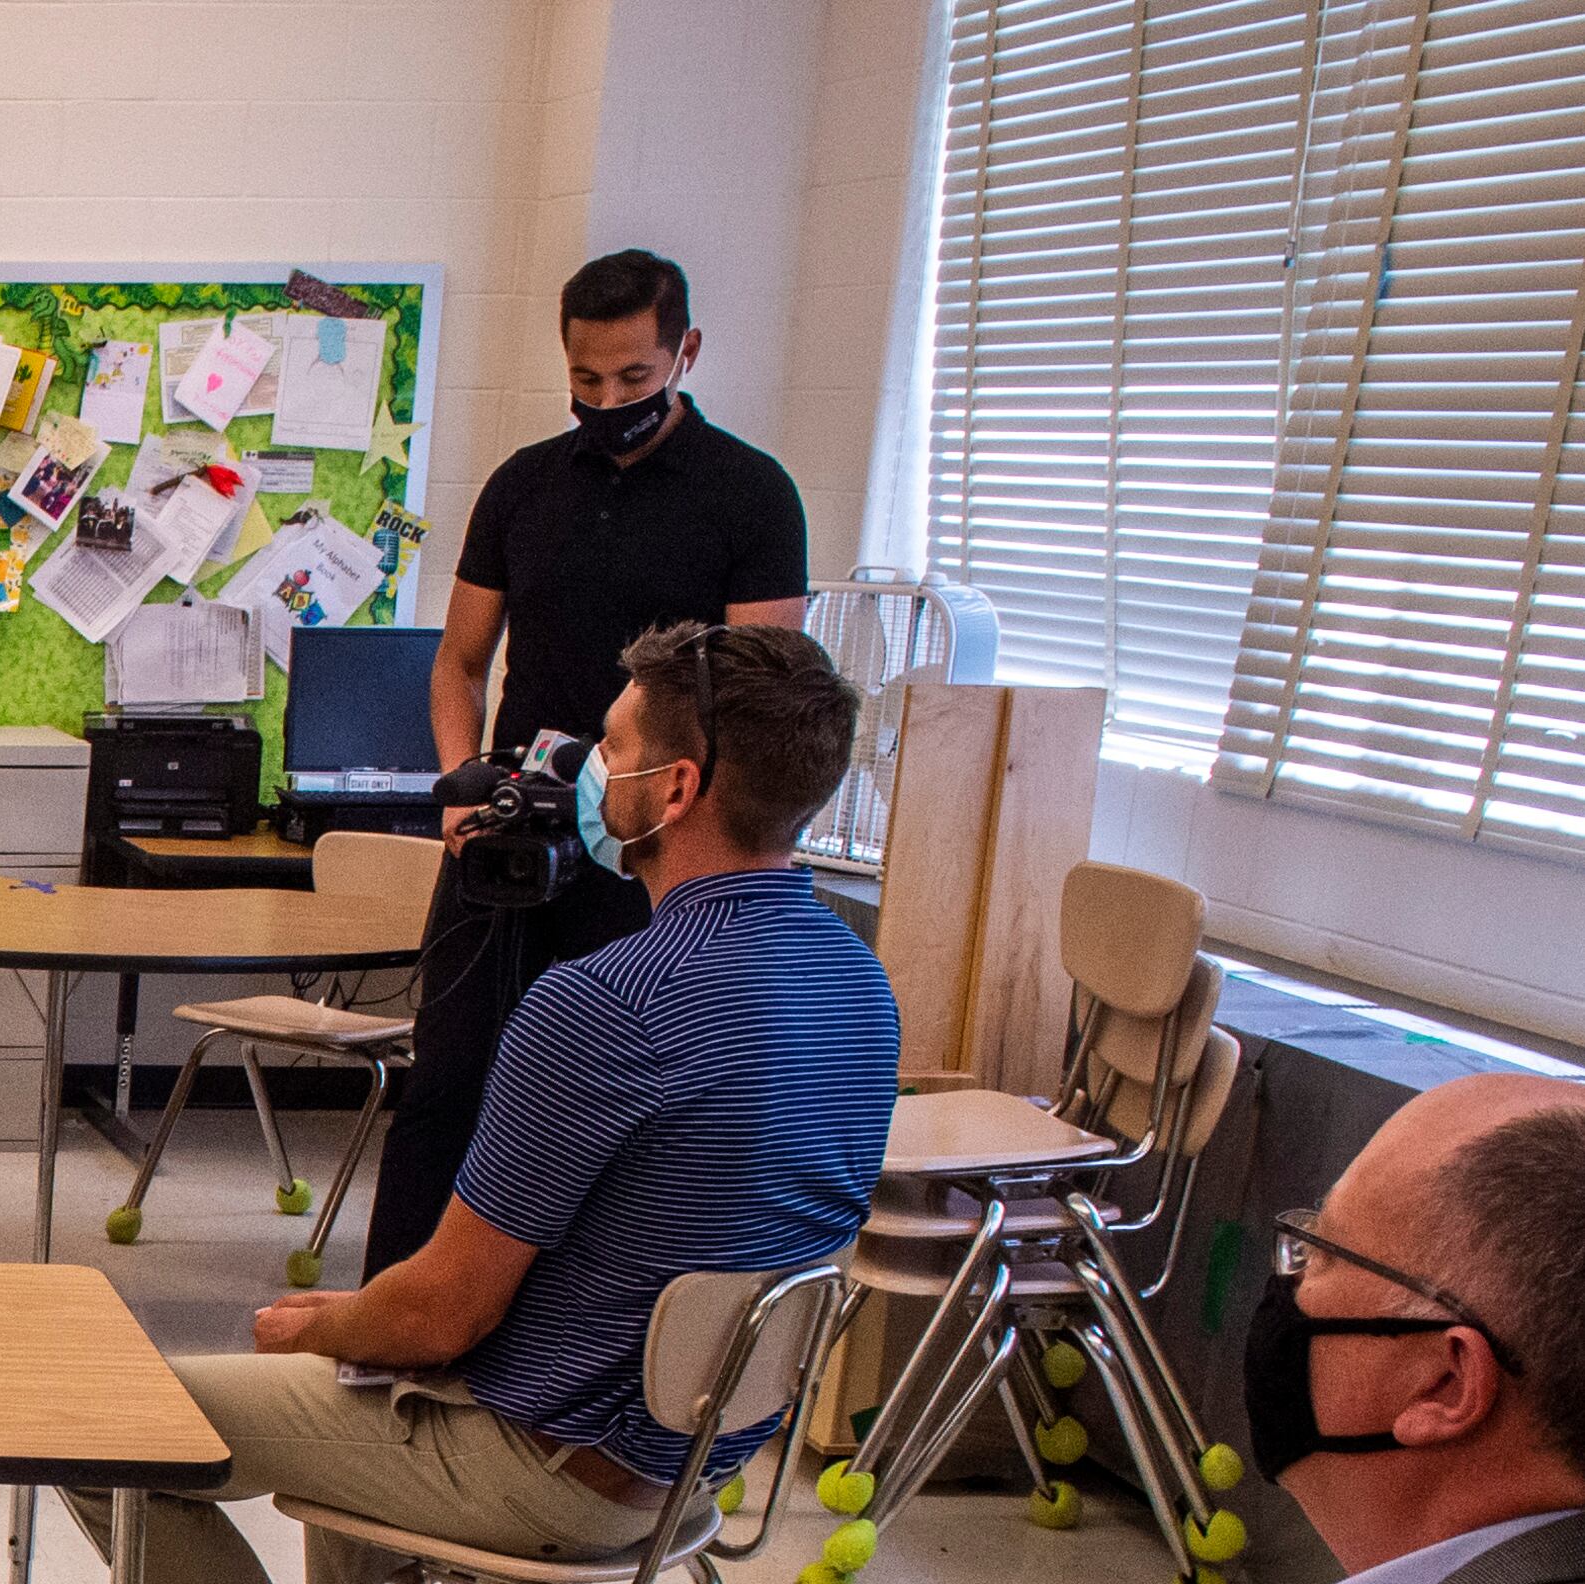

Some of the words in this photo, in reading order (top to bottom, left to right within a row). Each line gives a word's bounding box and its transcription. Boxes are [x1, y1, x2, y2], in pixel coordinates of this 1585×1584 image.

[376, 510, 427, 544] ROCK
[313, 538, 326, 554] My
[326, 550, 361, 582] Alphabet
[316, 562, 336, 581] Book
[371, 780, 389, 789] ONLY
